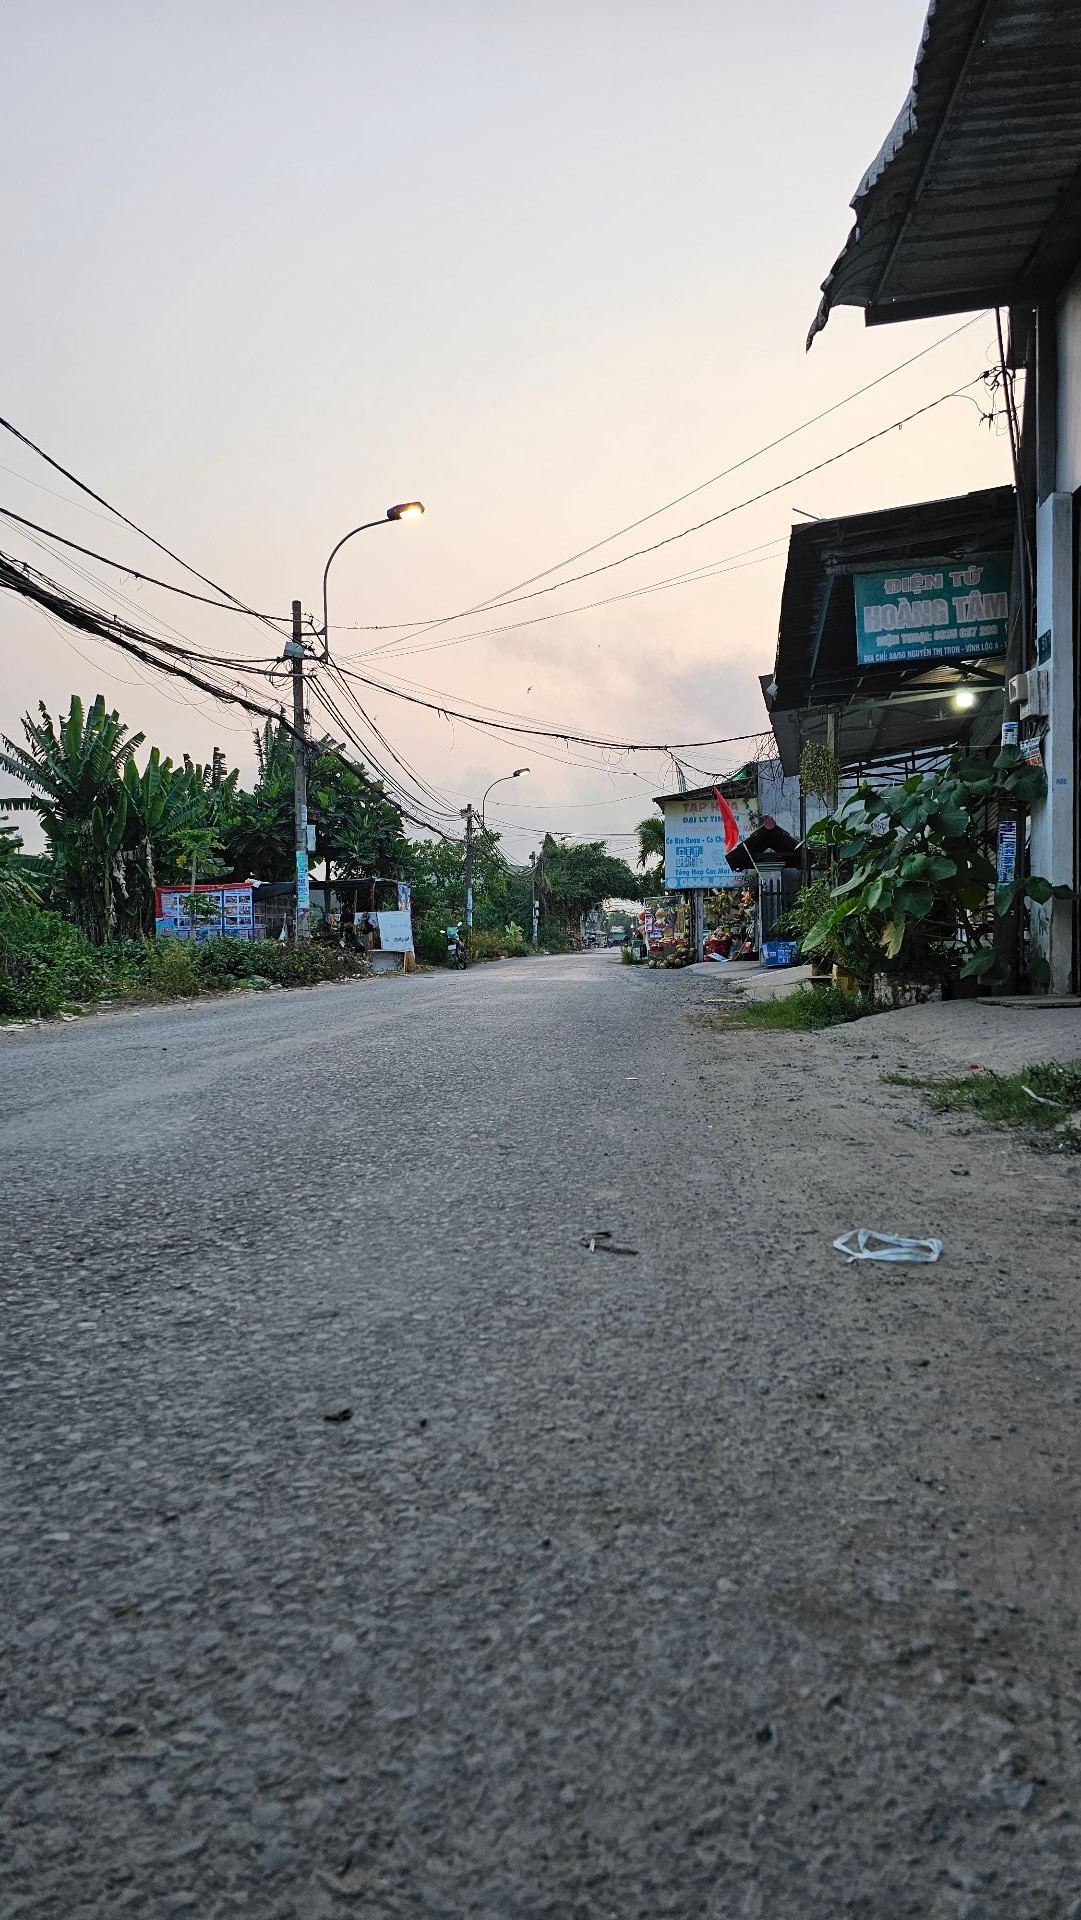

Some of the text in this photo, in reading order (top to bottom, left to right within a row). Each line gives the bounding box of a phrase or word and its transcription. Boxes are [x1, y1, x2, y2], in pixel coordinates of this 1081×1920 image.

[884, 566, 984, 594] ĐIỆN TỬ
[864, 590, 1008, 633] HOÀNG TÂM
